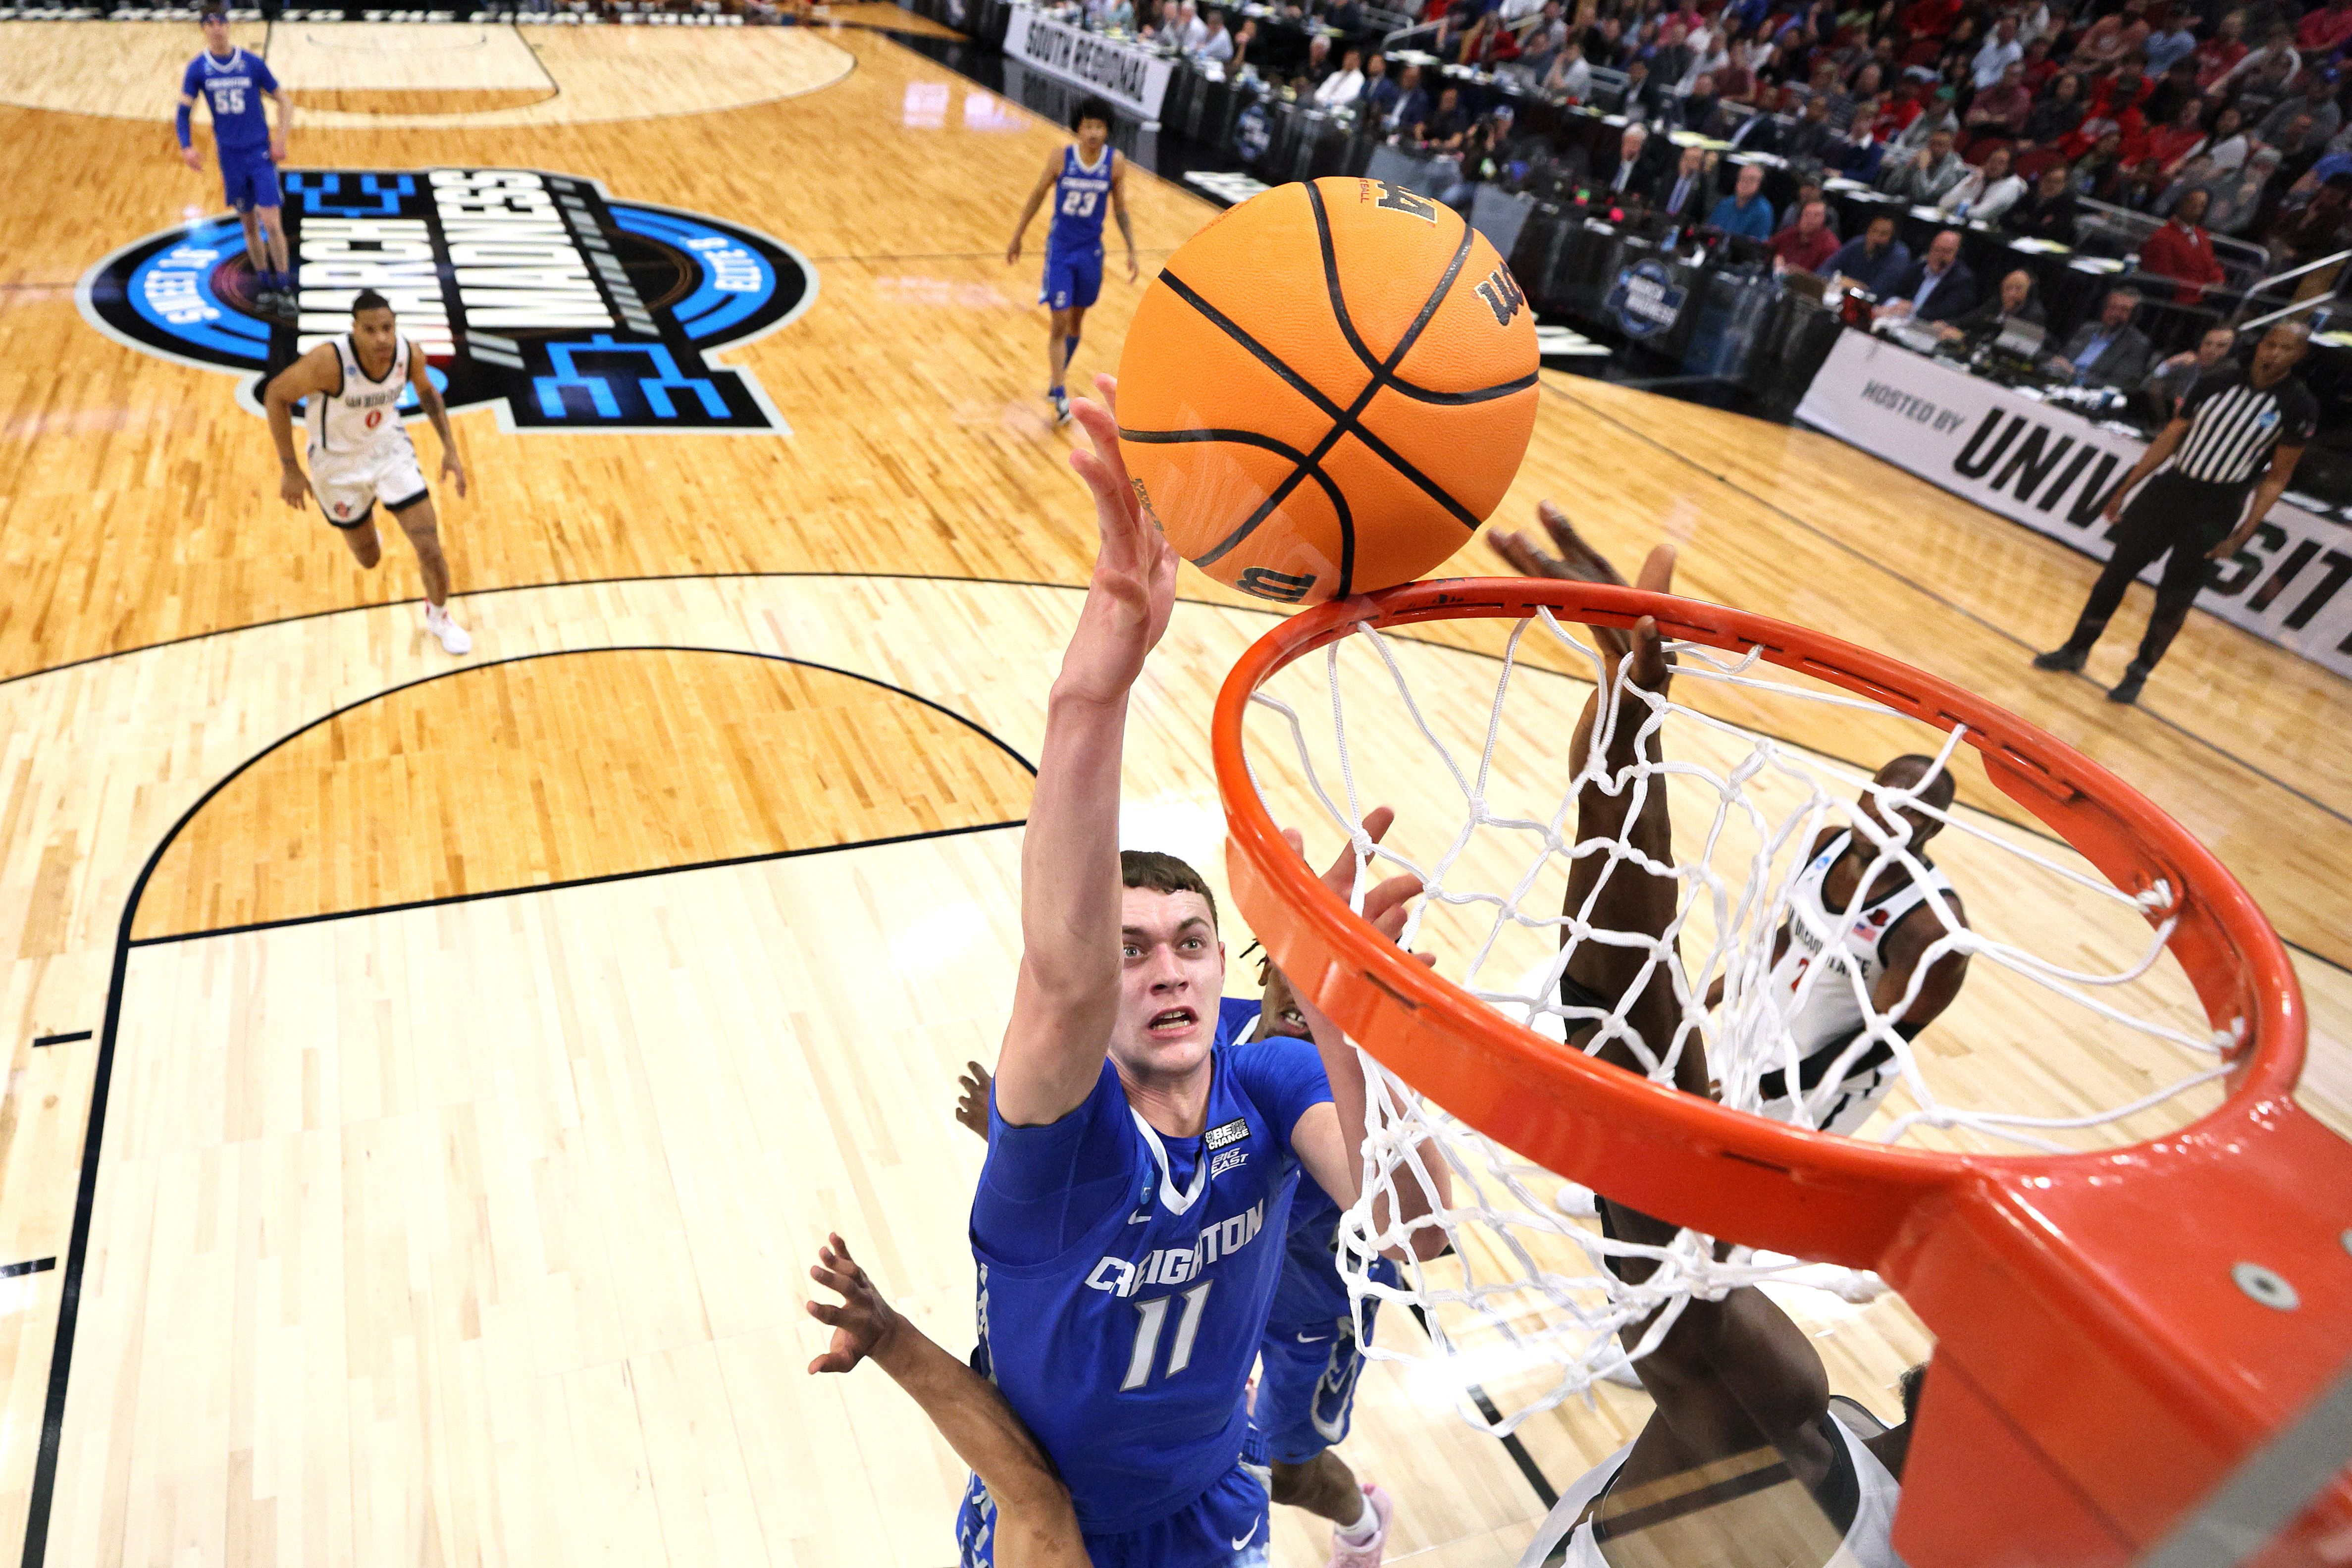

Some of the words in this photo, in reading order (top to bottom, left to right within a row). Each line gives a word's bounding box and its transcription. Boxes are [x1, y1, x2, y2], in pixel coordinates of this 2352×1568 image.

[1025, 21, 1074, 70] SOUTH
[1073, 39, 1147, 102] REGIONAL
[214, 89, 246, 114] 55
[1062, 190, 1098, 216] 23
[429, 169, 615, 328] MADNESS
[704, 249, 763, 292] ELITE
[366, 410, 381, 429] 0
[1861, 380, 1936, 424] HOSTED
[1934, 408, 1967, 434] BY
[1208, 1128, 1249, 1150] CHANGE
[1211, 1153, 1249, 1174] EAST
[1212, 1148, 1241, 1165] BIG
[1085, 1199, 1263, 1298] CREIGHTON
[1119, 1279, 1213, 1392] 11
